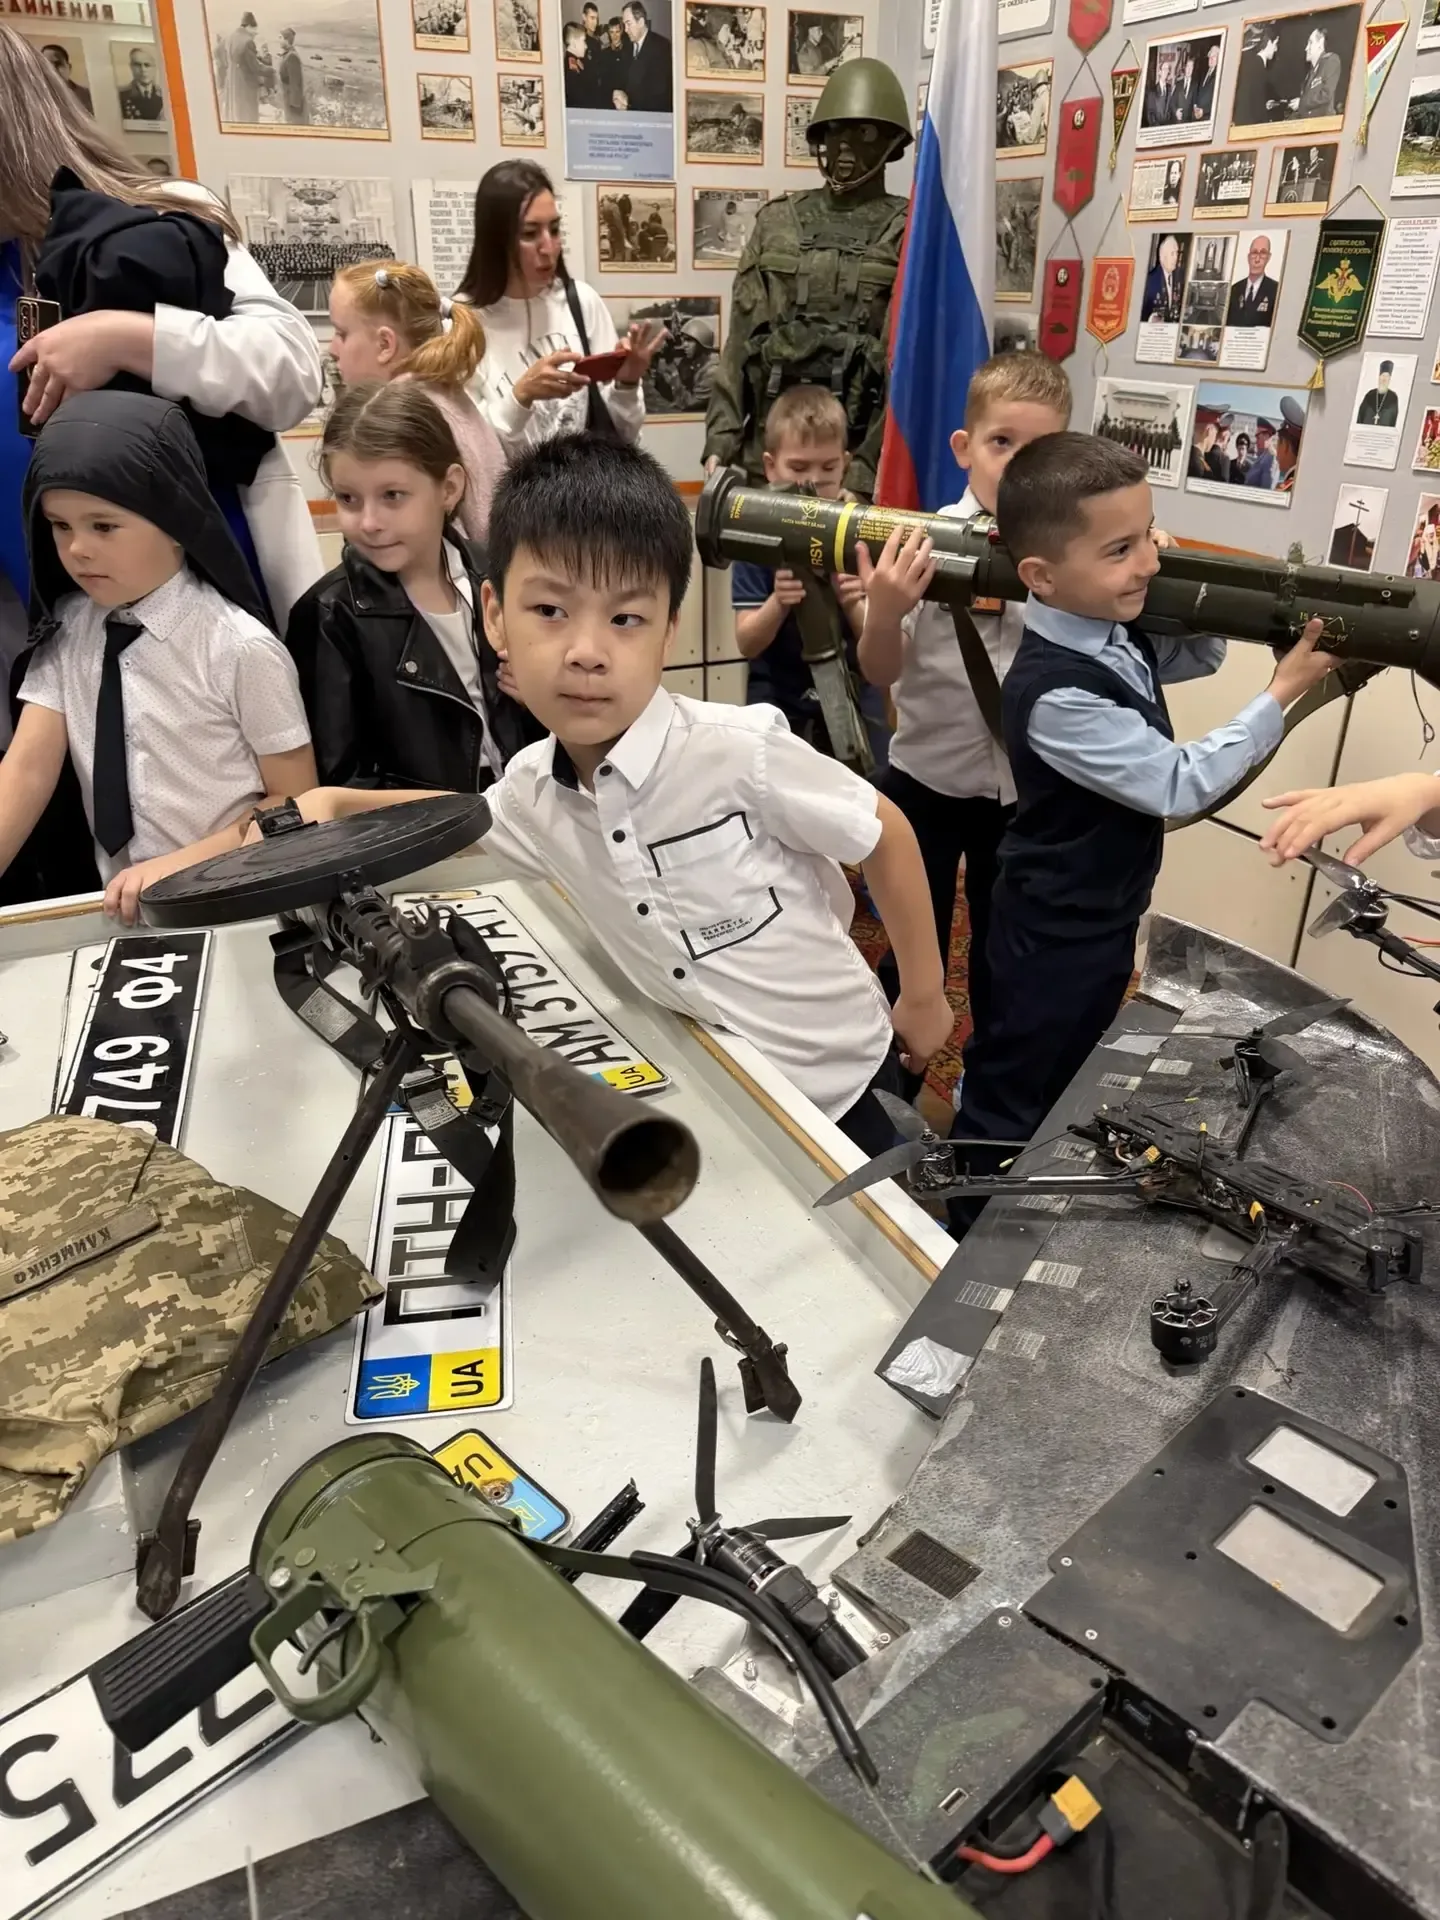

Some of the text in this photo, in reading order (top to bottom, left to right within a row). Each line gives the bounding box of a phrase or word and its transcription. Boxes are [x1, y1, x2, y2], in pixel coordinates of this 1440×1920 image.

[809, 536, 824, 567] RSV
[701, 917, 744, 936] NARRATE
[112, 953, 189, 1010] Ф4
[620, 1066, 646, 1086] UA
[13, 1226, 113, 1285] КЛИМЕНКО
[450, 1358, 485, 1398] UA
